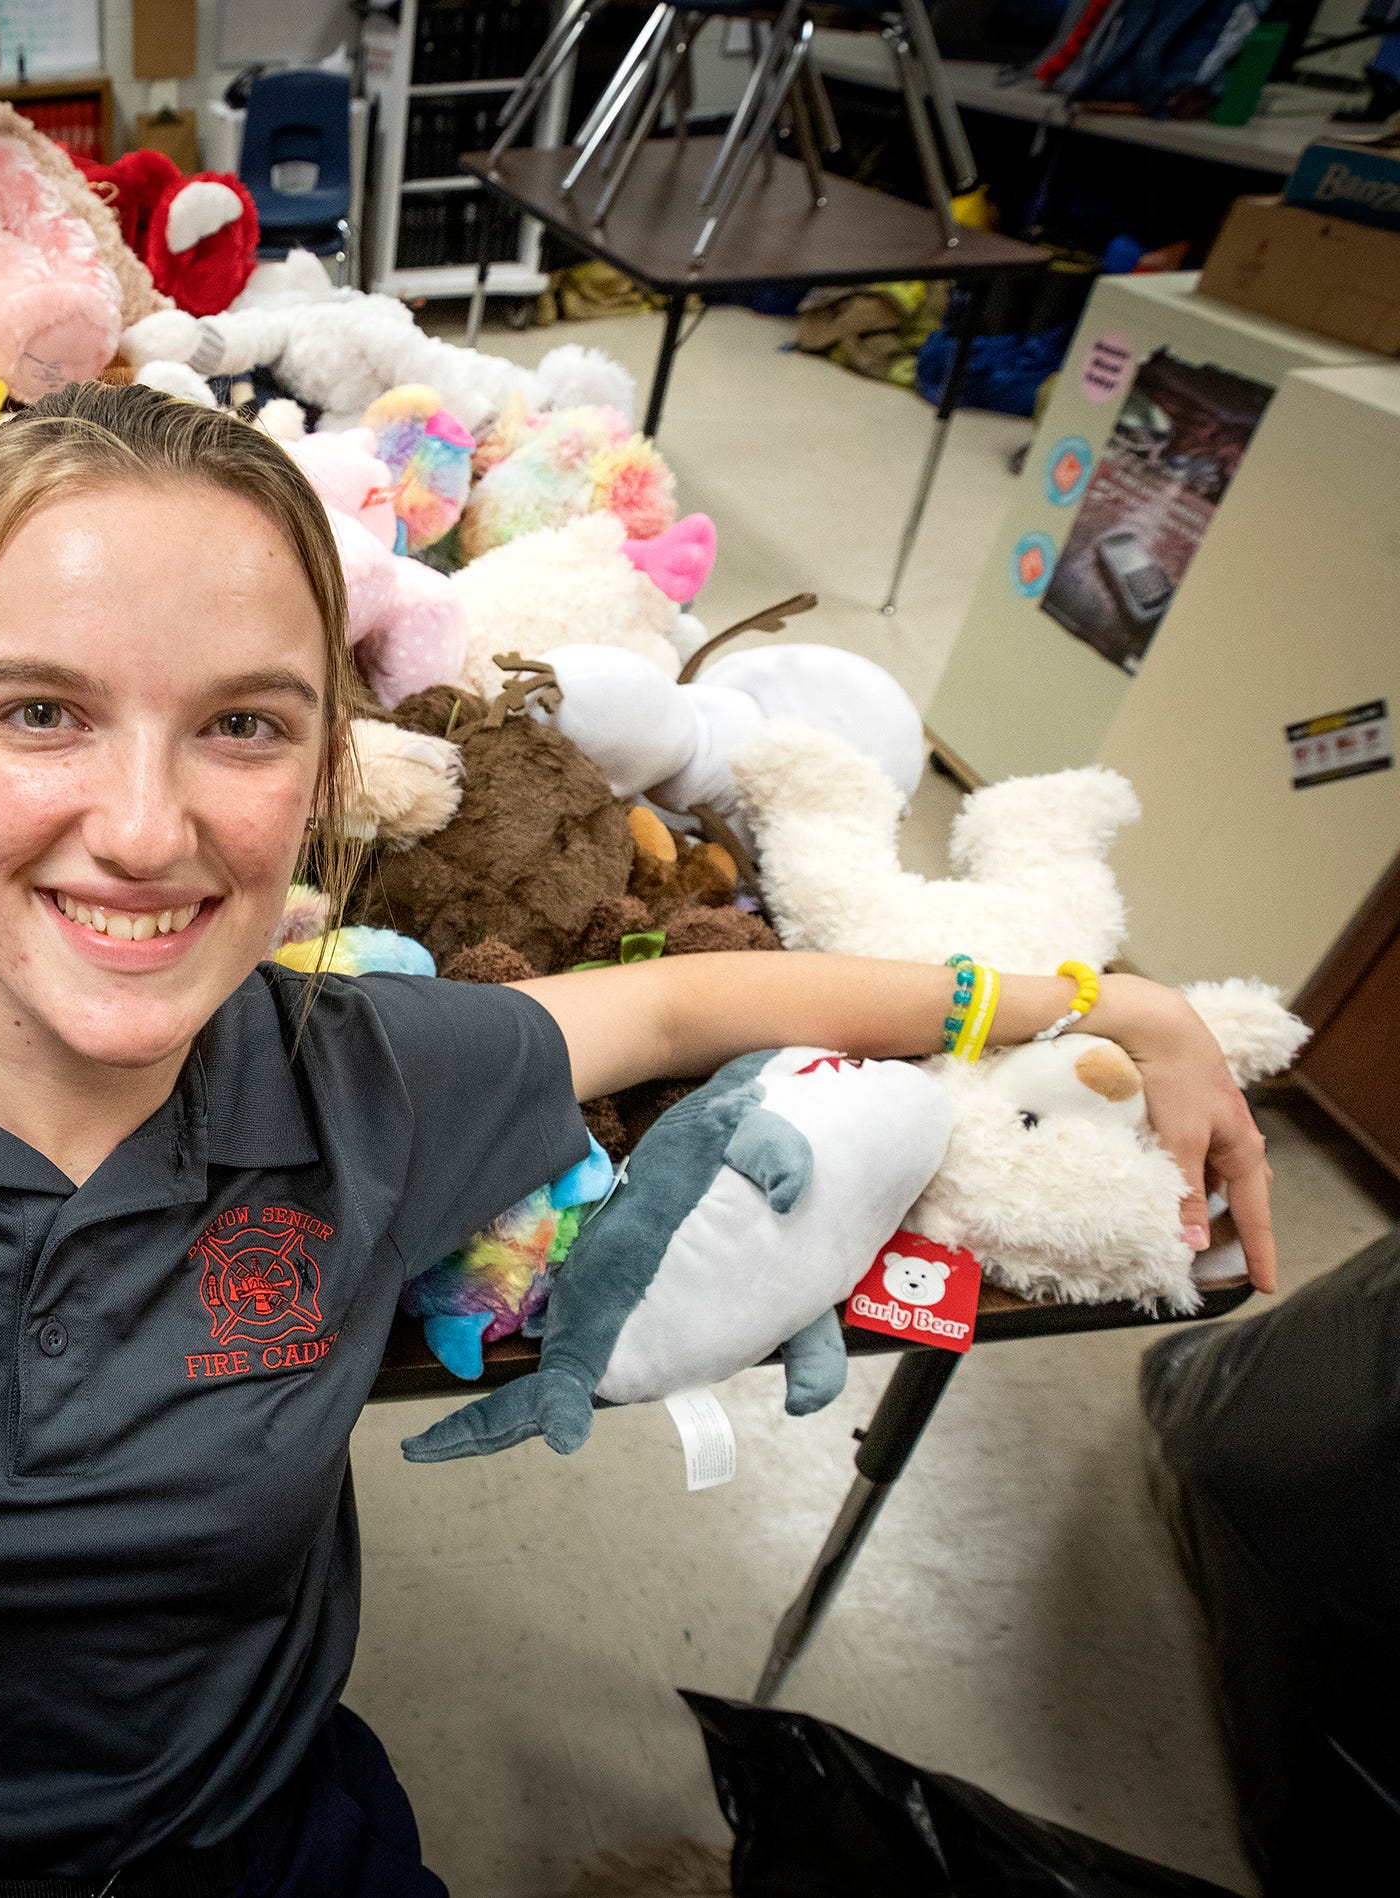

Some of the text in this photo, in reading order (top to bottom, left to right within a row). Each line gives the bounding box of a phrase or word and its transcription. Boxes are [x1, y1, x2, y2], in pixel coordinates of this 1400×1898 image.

[262, 1206, 334, 1242] SENIOR
[851, 1294, 970, 1340] Curly Bear
[185, 1330, 340, 1378] FIRE CADE
